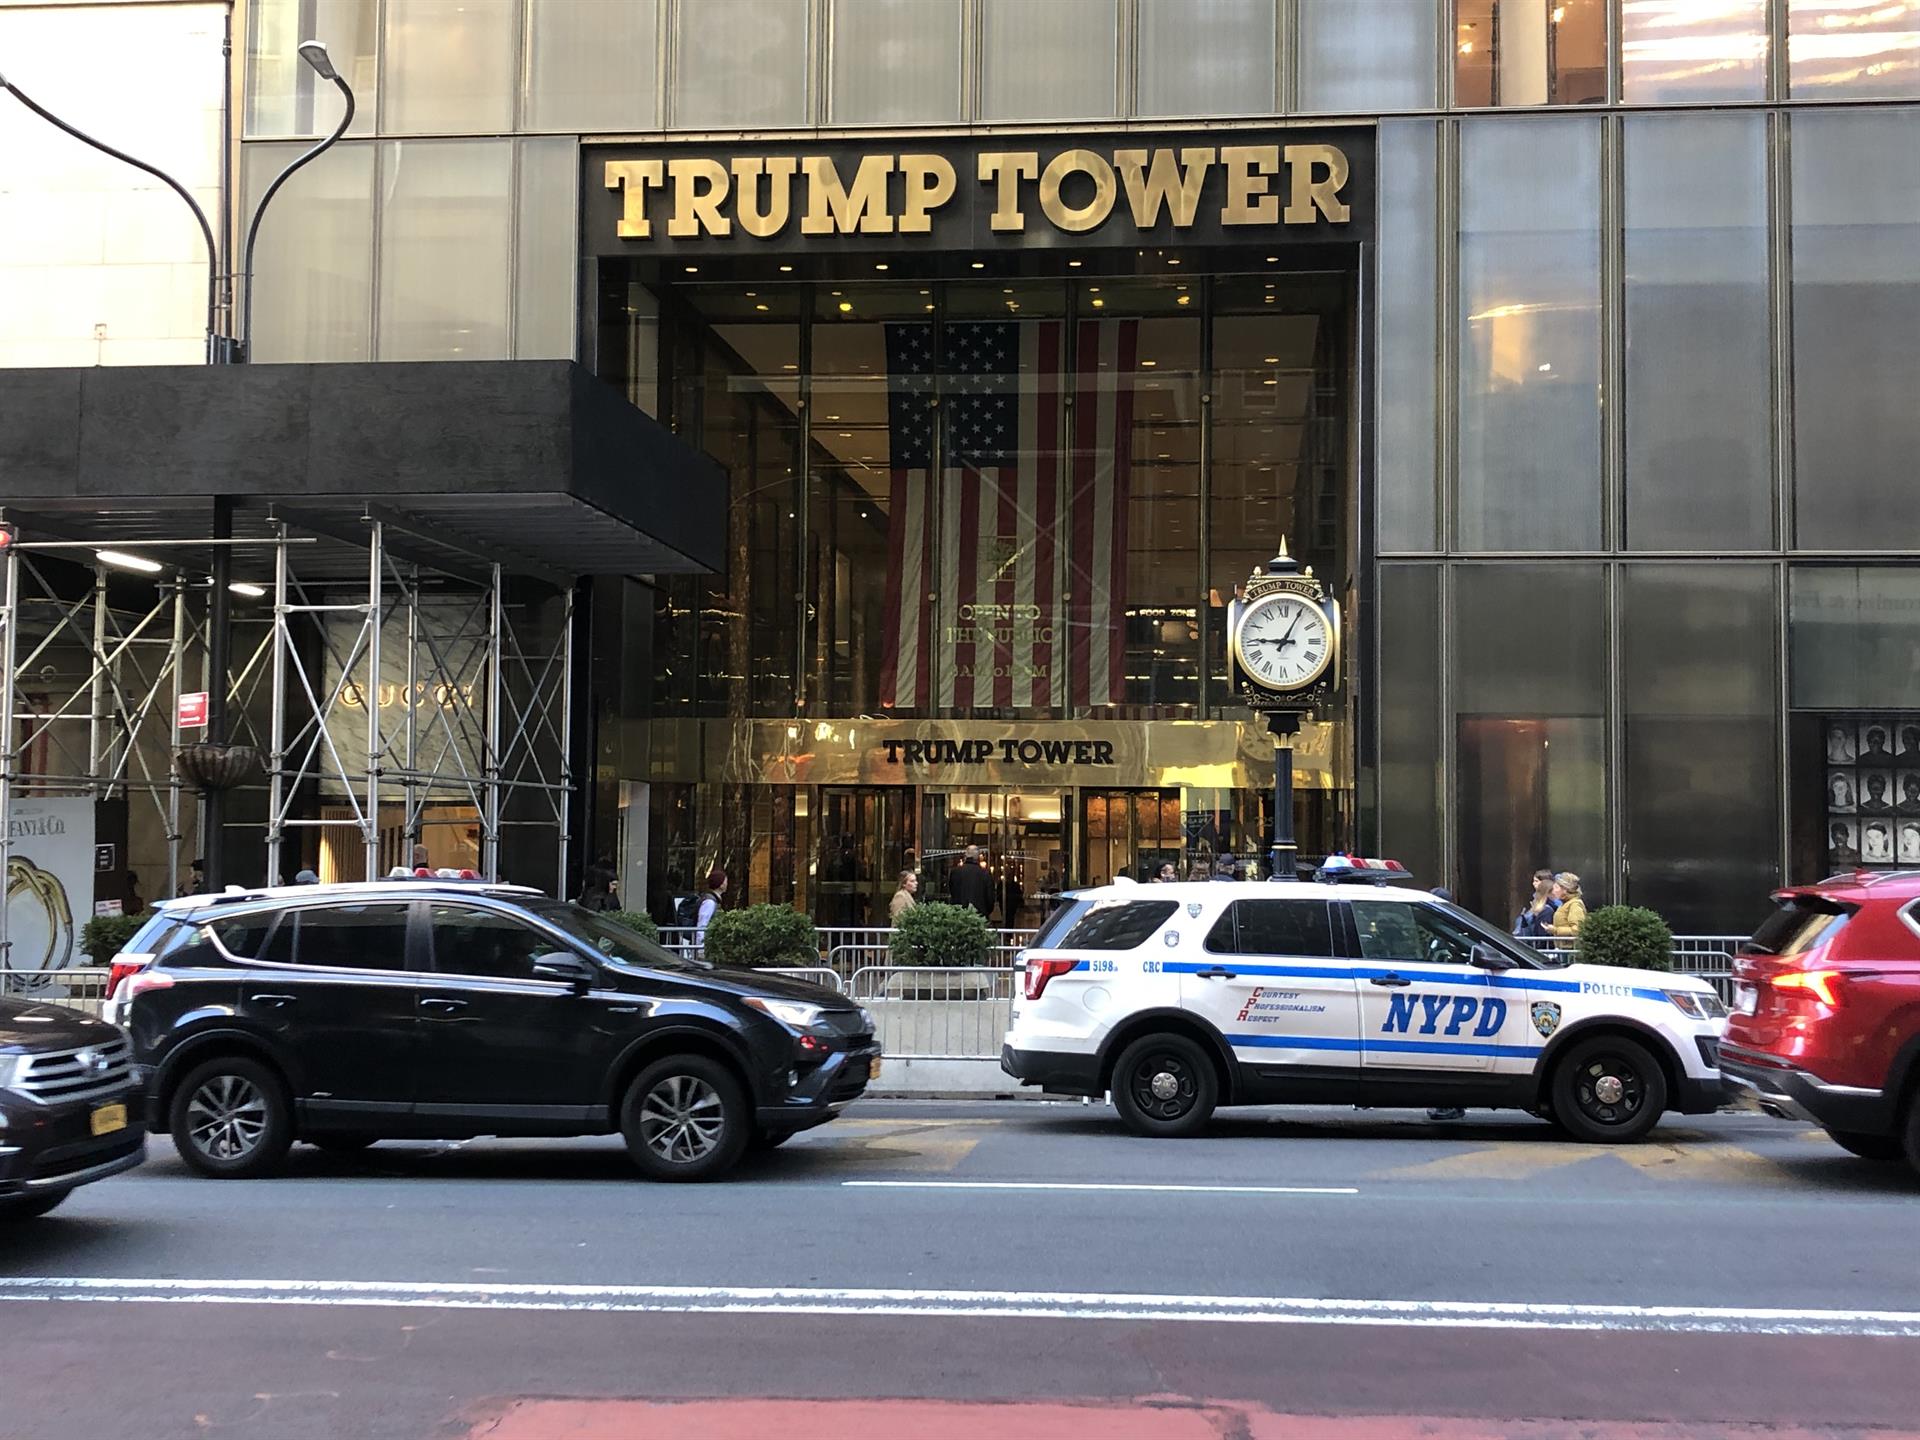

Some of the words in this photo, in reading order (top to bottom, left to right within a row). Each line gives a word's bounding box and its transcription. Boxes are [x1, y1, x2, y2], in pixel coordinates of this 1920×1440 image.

[604, 153, 957, 238] TRUMP
[978, 143, 1351, 233] TOWER
[1251, 582, 1282, 596] TRUMP
[1285, 582, 1314, 596] TOWER
[959, 604, 1011, 620] OPEN
[1013, 604, 1041, 620] TO
[1139, 608, 1166, 617] FOOD
[340, 683, 474, 708] GUCCI
[883, 739, 994, 764] TRUMP
[998, 739, 1114, 765] TOWER
[1092, 960, 1114, 972] 5198
[1142, 961, 1160, 973] CRC
[1252, 986, 1301, 999] COURTESY
[1583, 983, 1630, 996] POLICE
[1244, 998, 1326, 1012] PROFESSIONALISM
[1236, 1010, 1280, 1023] RESPECT
[1381, 992, 1507, 1037] NYPD
